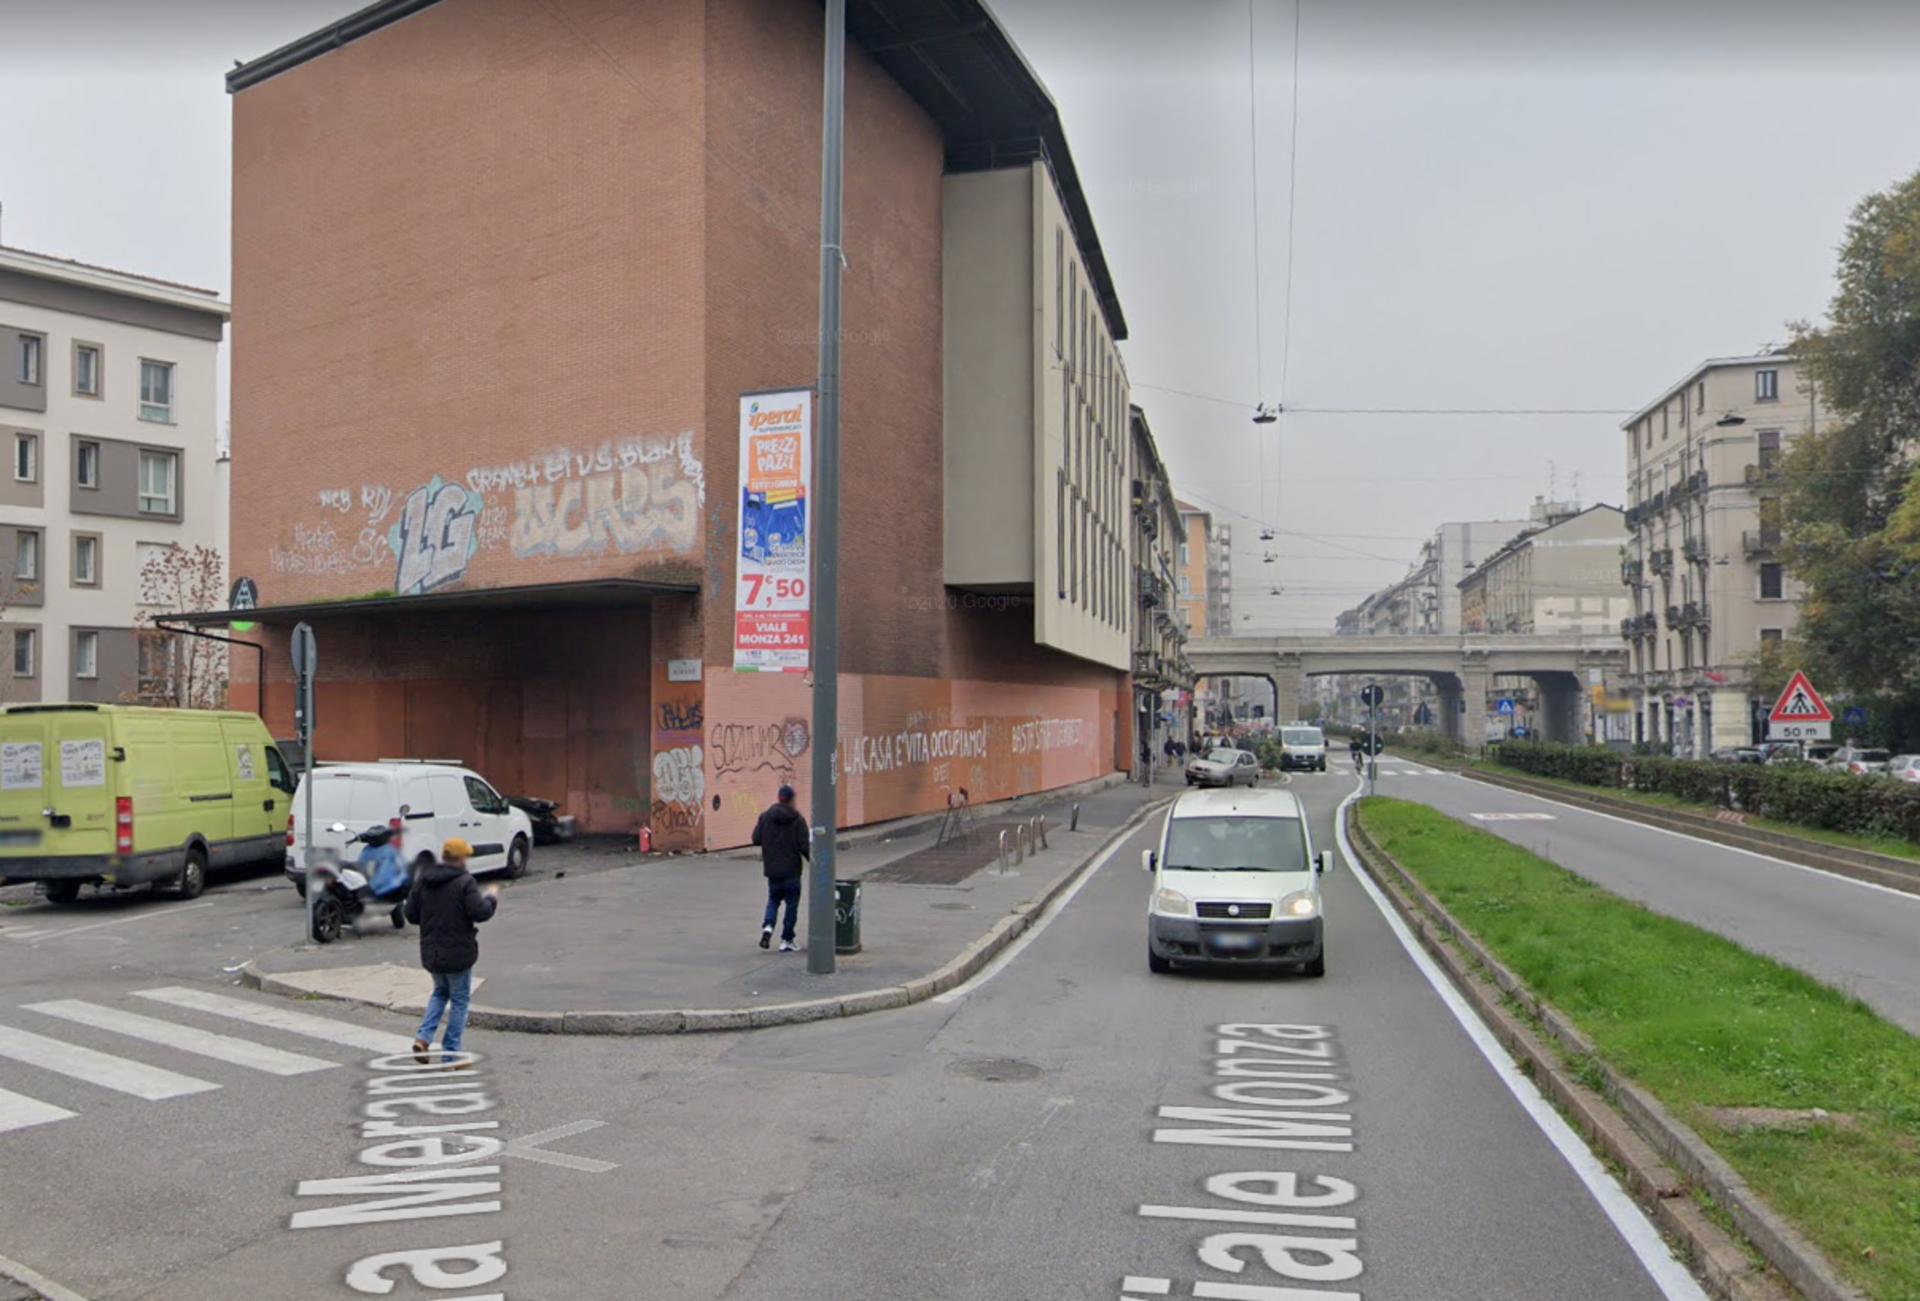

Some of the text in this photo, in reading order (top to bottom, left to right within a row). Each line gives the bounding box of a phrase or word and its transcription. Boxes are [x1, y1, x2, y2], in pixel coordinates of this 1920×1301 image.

[756, 622, 788, 632] VIALE
[739, 634, 804, 645] MONZA 241
[1783, 727, 1817, 737] 50 m
